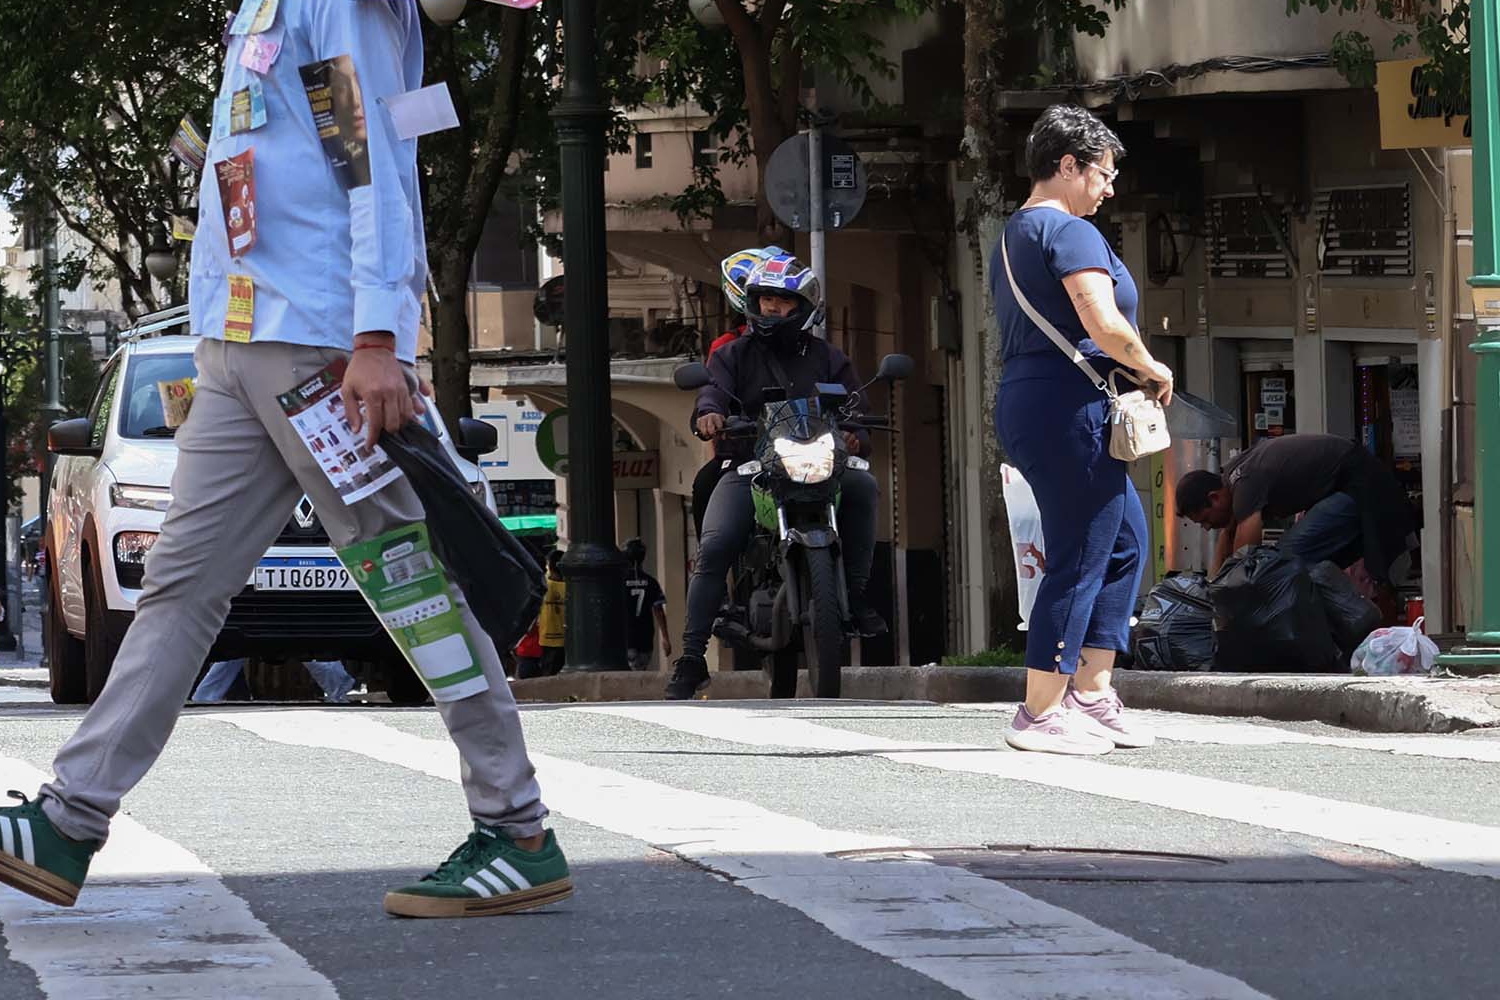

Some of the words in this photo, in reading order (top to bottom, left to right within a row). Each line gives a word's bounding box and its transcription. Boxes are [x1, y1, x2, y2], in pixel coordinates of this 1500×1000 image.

[300, 379, 324, 399] Natal
[1266, 394, 1284, 402] VISA
[265, 569, 349, 588] TIQ6B99
[631, 589, 645, 617] 7
